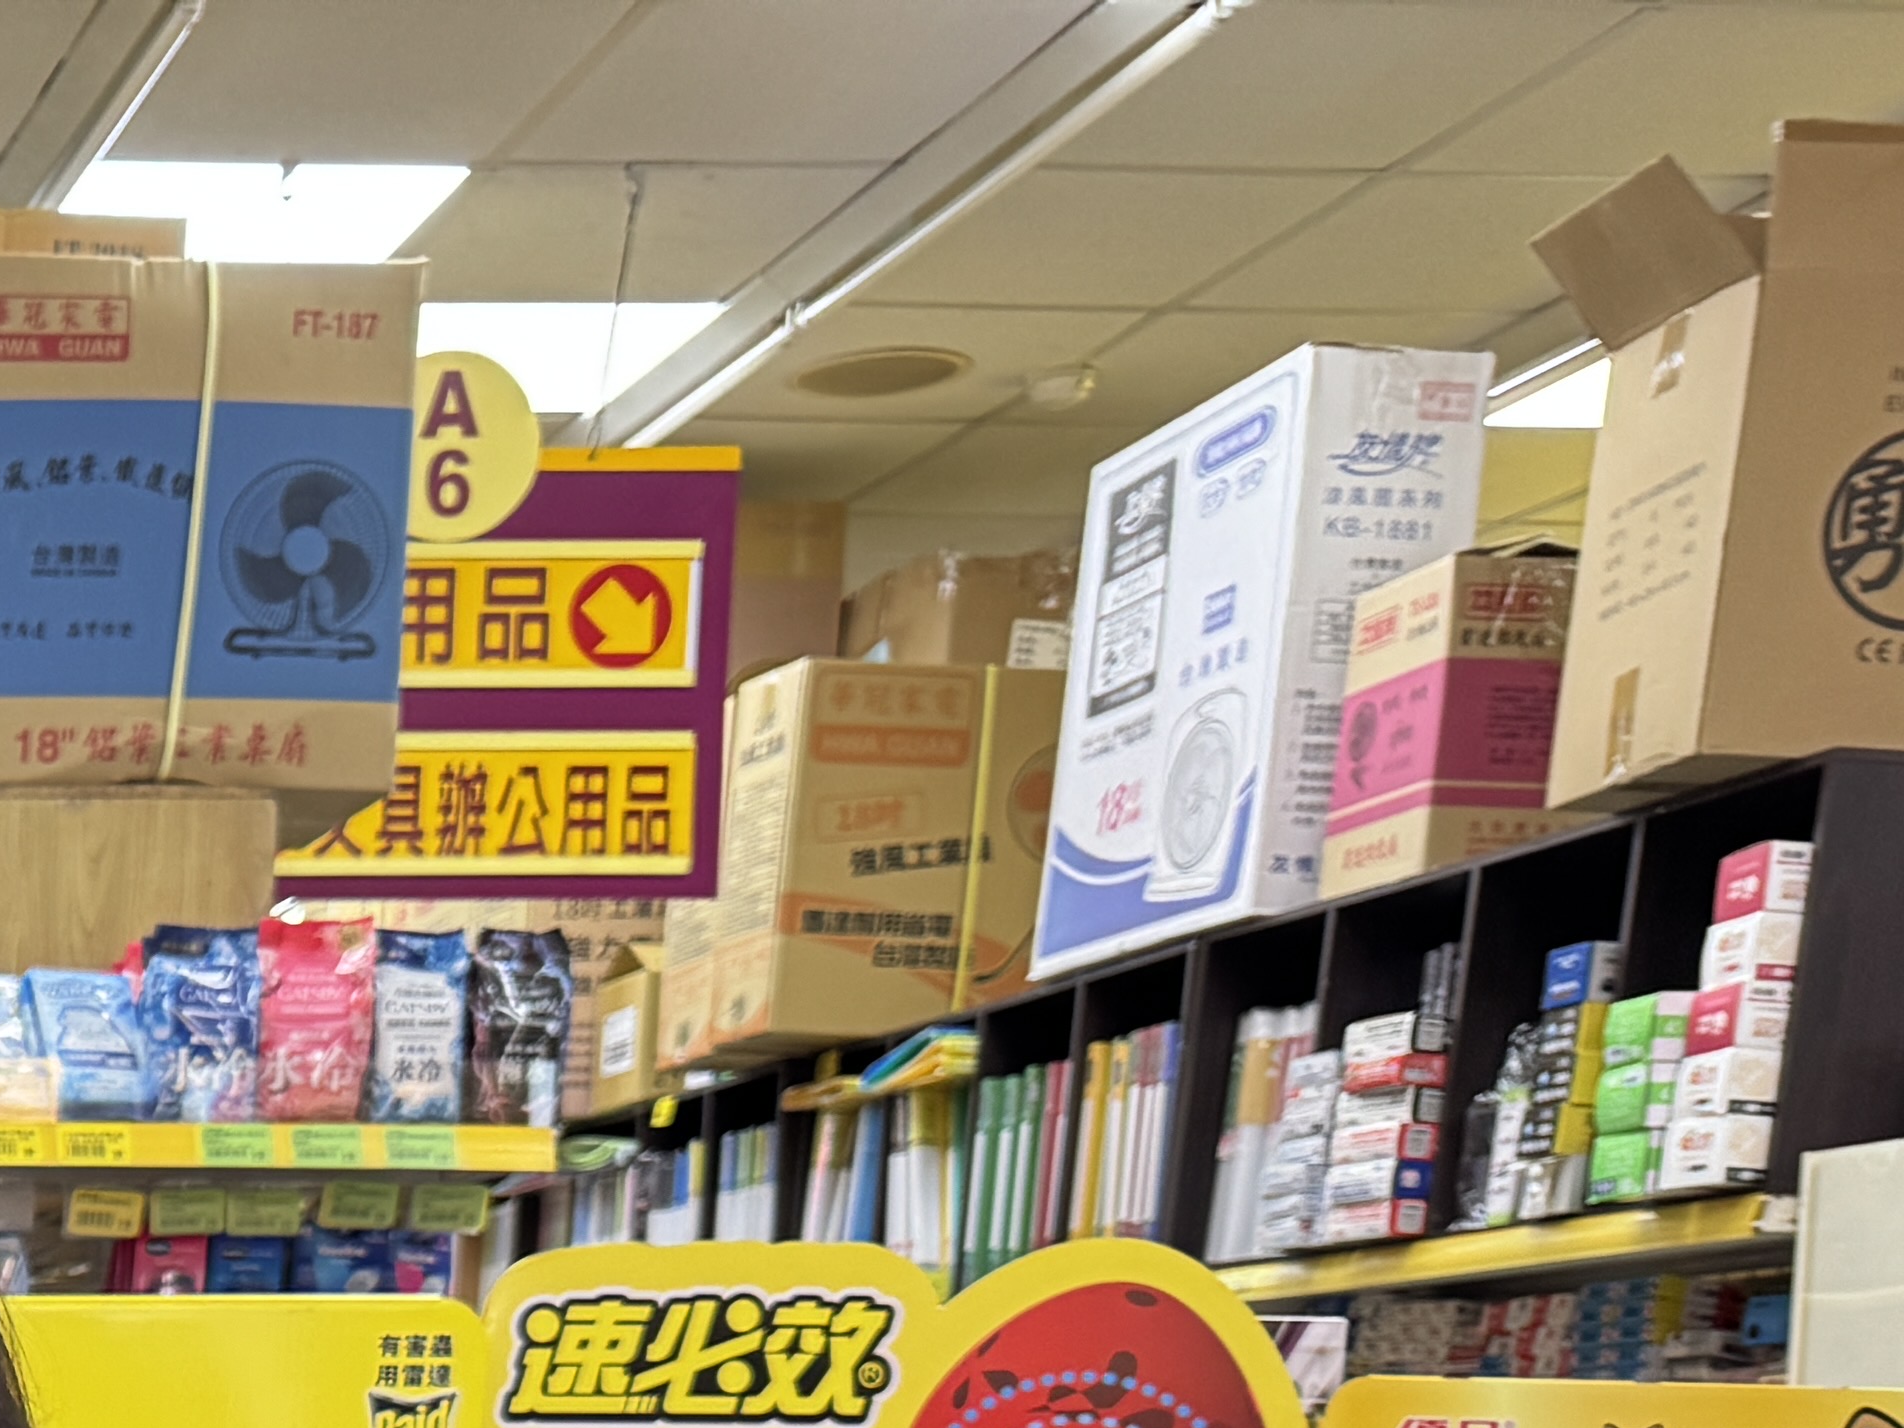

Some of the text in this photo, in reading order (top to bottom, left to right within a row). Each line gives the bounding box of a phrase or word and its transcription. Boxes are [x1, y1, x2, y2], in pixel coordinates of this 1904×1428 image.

[293, 308, 380, 340] FT-187
[420, 371, 479, 437] A
[426, 449, 471, 515] 6
[378, 1334, 452, 1359] 有害蟲
[502, 1295, 890, 1423] 速必效
[375, 1364, 452, 1389] 用雷達
